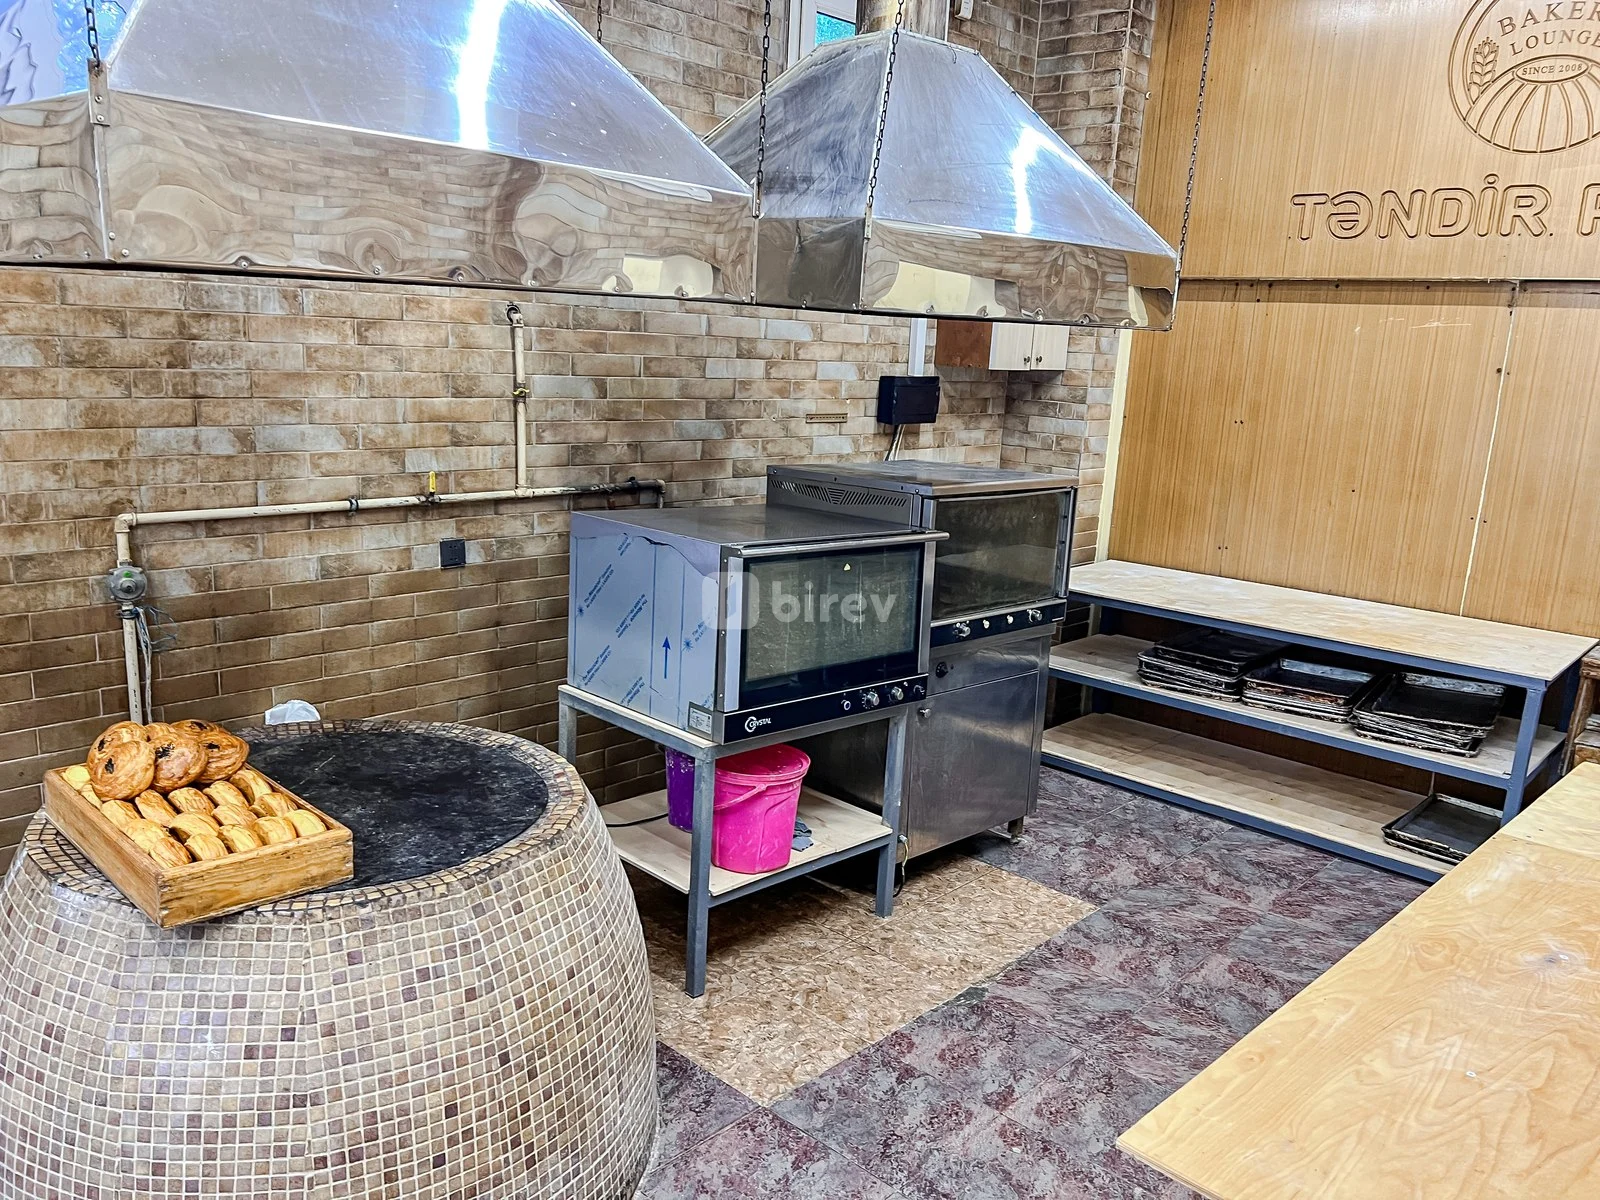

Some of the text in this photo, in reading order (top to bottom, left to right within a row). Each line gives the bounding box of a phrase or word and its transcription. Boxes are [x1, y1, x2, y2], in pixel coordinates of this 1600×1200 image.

[1521, 63, 1583, 76] SINCE 2008
[1290, 173, 1552, 241] TƏNDİR
